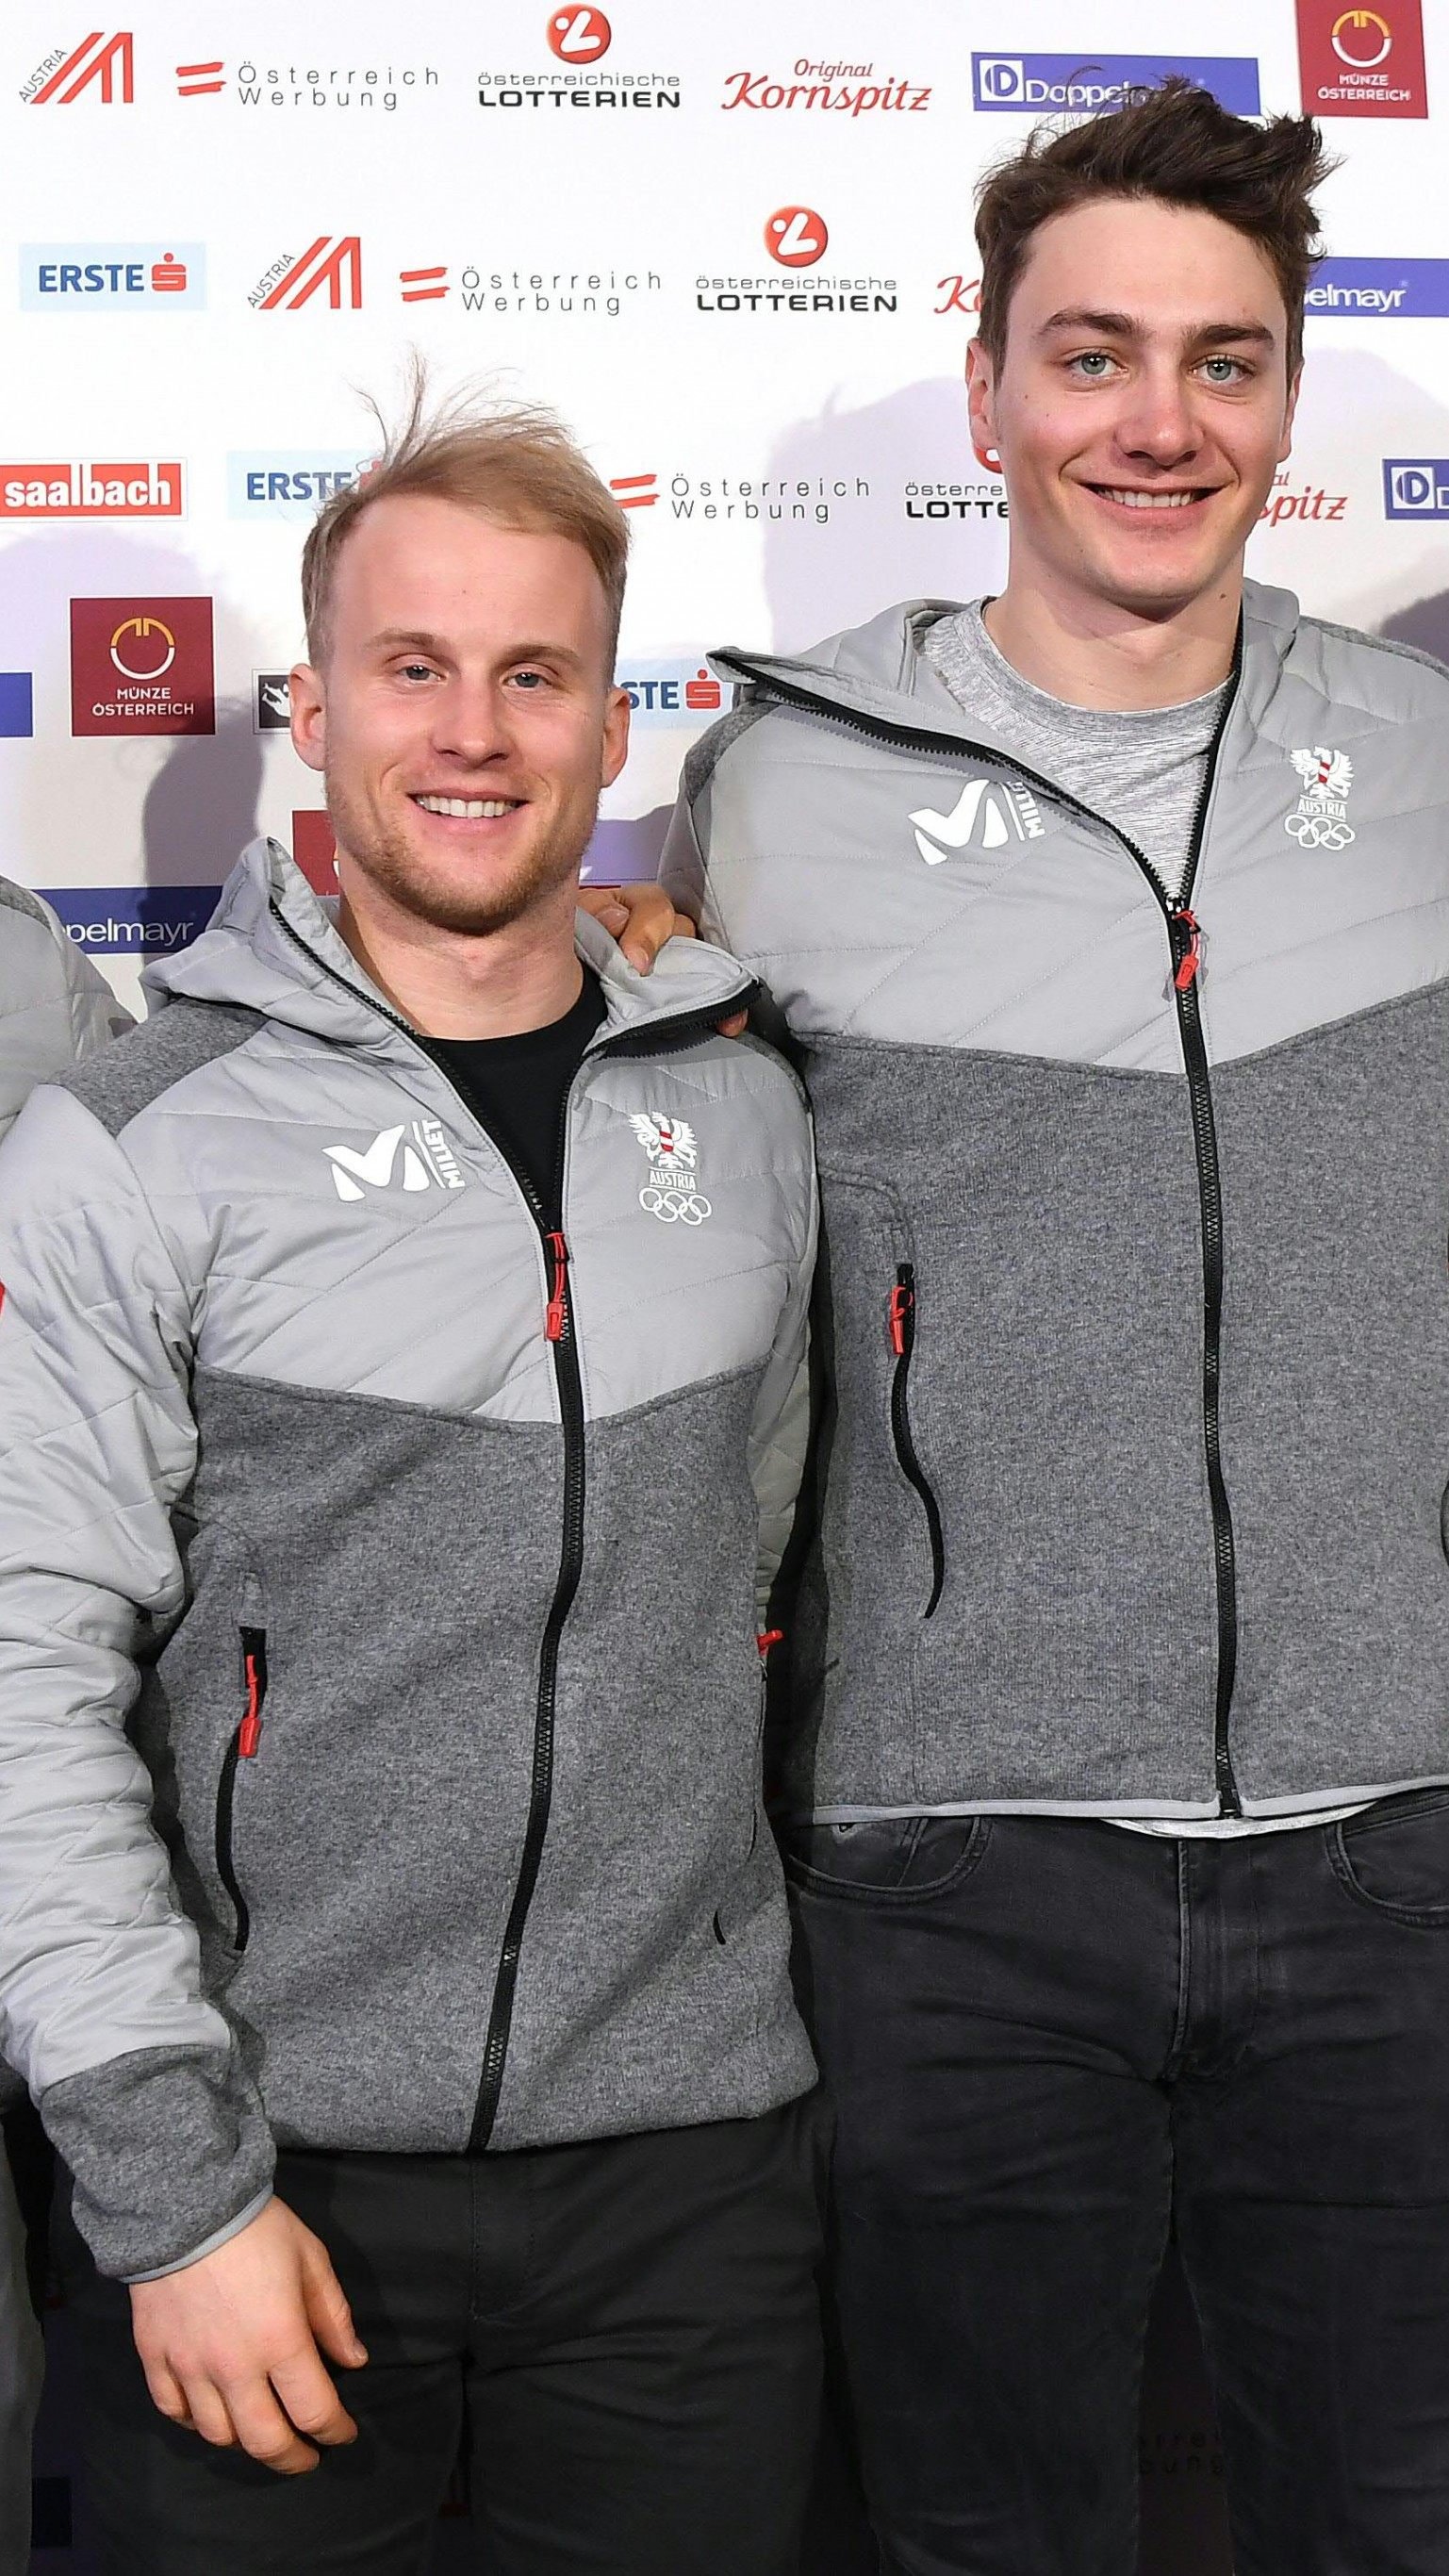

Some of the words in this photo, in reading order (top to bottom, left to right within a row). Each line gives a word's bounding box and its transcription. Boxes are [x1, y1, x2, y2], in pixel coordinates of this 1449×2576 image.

[19, 49, 68, 103] AUSTRIA
[239, 61, 437, 85] Österreich
[479, 73, 679, 86] österreichische
[794, 58, 873, 82] Original
[1339, 74, 1389, 86] MÜNZE
[239, 88, 396, 110] Werbung
[479, 91, 680, 107] LOTTERIEN
[721, 72, 932, 117] Kornspitz
[1318, 86, 1411, 101] ÖSTERREICH
[40, 264, 144, 292] ERSTE
[247, 253, 296, 310] AUSTRIA
[462, 267, 660, 289] Österreich
[697, 276, 896, 289] österreichische
[462, 293, 618, 316] Werbung
[698, 295, 897, 312] LOTTERIEN
[1305, 285, 1407, 312] elmayr
[4, 462, 172, 506] saalbach
[672, 473, 868, 496] Österreich
[672, 501, 828, 523] Werbung
[117, 687, 171, 701] MÜNZE
[620, 681, 680, 710] STE
[92, 702, 194, 717] ÖSTERREICH
[1297, 799, 1346, 819] AUSTRIA
[62, 917, 193, 947] pelmayr
[650, 1170, 697, 1191] AUSTRIA
